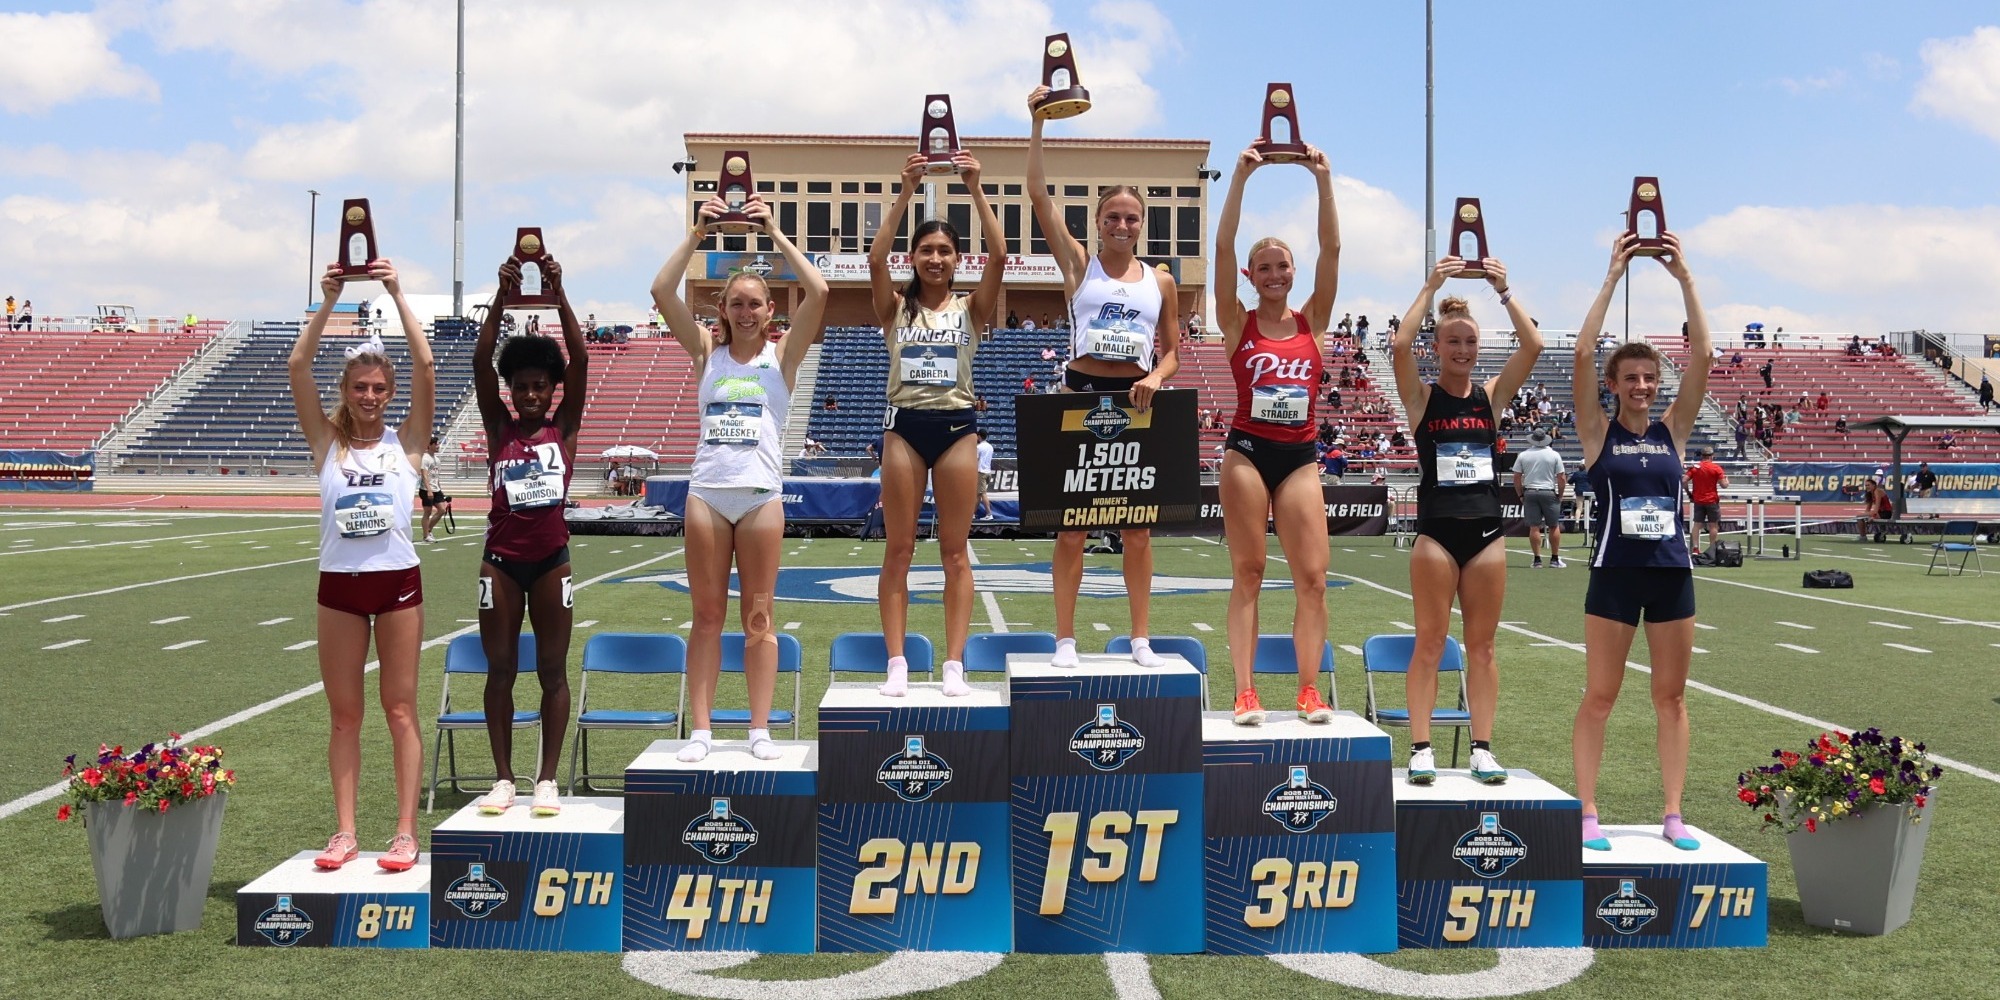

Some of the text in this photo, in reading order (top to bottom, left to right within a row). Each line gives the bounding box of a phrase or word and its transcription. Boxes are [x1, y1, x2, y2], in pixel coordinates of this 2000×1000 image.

[942, 313, 962, 329] 10
[896, 326, 971, 346] WINGATE
[1102, 334, 1130, 343] KLAUDIA
[1094, 342, 1136, 354] O'MALLEY
[910, 370, 948, 379] CABRERA
[1246, 352, 1312, 388] Pitt
[1261, 410, 1298, 419] STRADER
[1428, 418, 1458, 432] STAN
[708, 428, 757, 438] MCCLESKEY
[545, 446, 560, 470] 2
[1078, 442, 1140, 468] 1,500
[346, 474, 386, 487] LEE
[1063, 466, 1156, 492] METERS
[1455, 470, 1476, 478] WILD
[1778, 475, 1824, 491] TRACK
[1828, 475, 1838, 491] &
[515, 488, 558, 502] KOOMSON
[1092, 497, 1128, 506] WOMEN'S
[350, 510, 378, 519] ESTELLA
[1063, 505, 1158, 526] CHAMPION
[1338, 504, 1348, 517] &
[1350, 504, 1382, 517] FIELD
[346, 519, 386, 531] CLEMONS
[1636, 524, 1664, 532] WALSH
[1072, 739, 1142, 749] CHAMPIONSHIPS
[880, 771, 950, 780] CHAMPIONSHIPS
[1265, 801, 1334, 811] CHAMPIONSHIPS
[685, 832, 756, 842] CHAMPIONSHIPS
[1455, 847, 1524, 856] CHAMPIONSHIPS
[1040, 810, 1178, 914] 1ST
[849, 838, 981, 914] 2ND
[447, 892, 506, 900] CHAMPIONSHIPS
[534, 868, 614, 916] 6TH
[1244, 858, 1359, 927] 3RD
[666, 874, 774, 938] 4TH
[1690, 885, 1754, 928] 7TH
[1442, 886, 1536, 941] 5TH
[356, 904, 415, 938] 8TH
